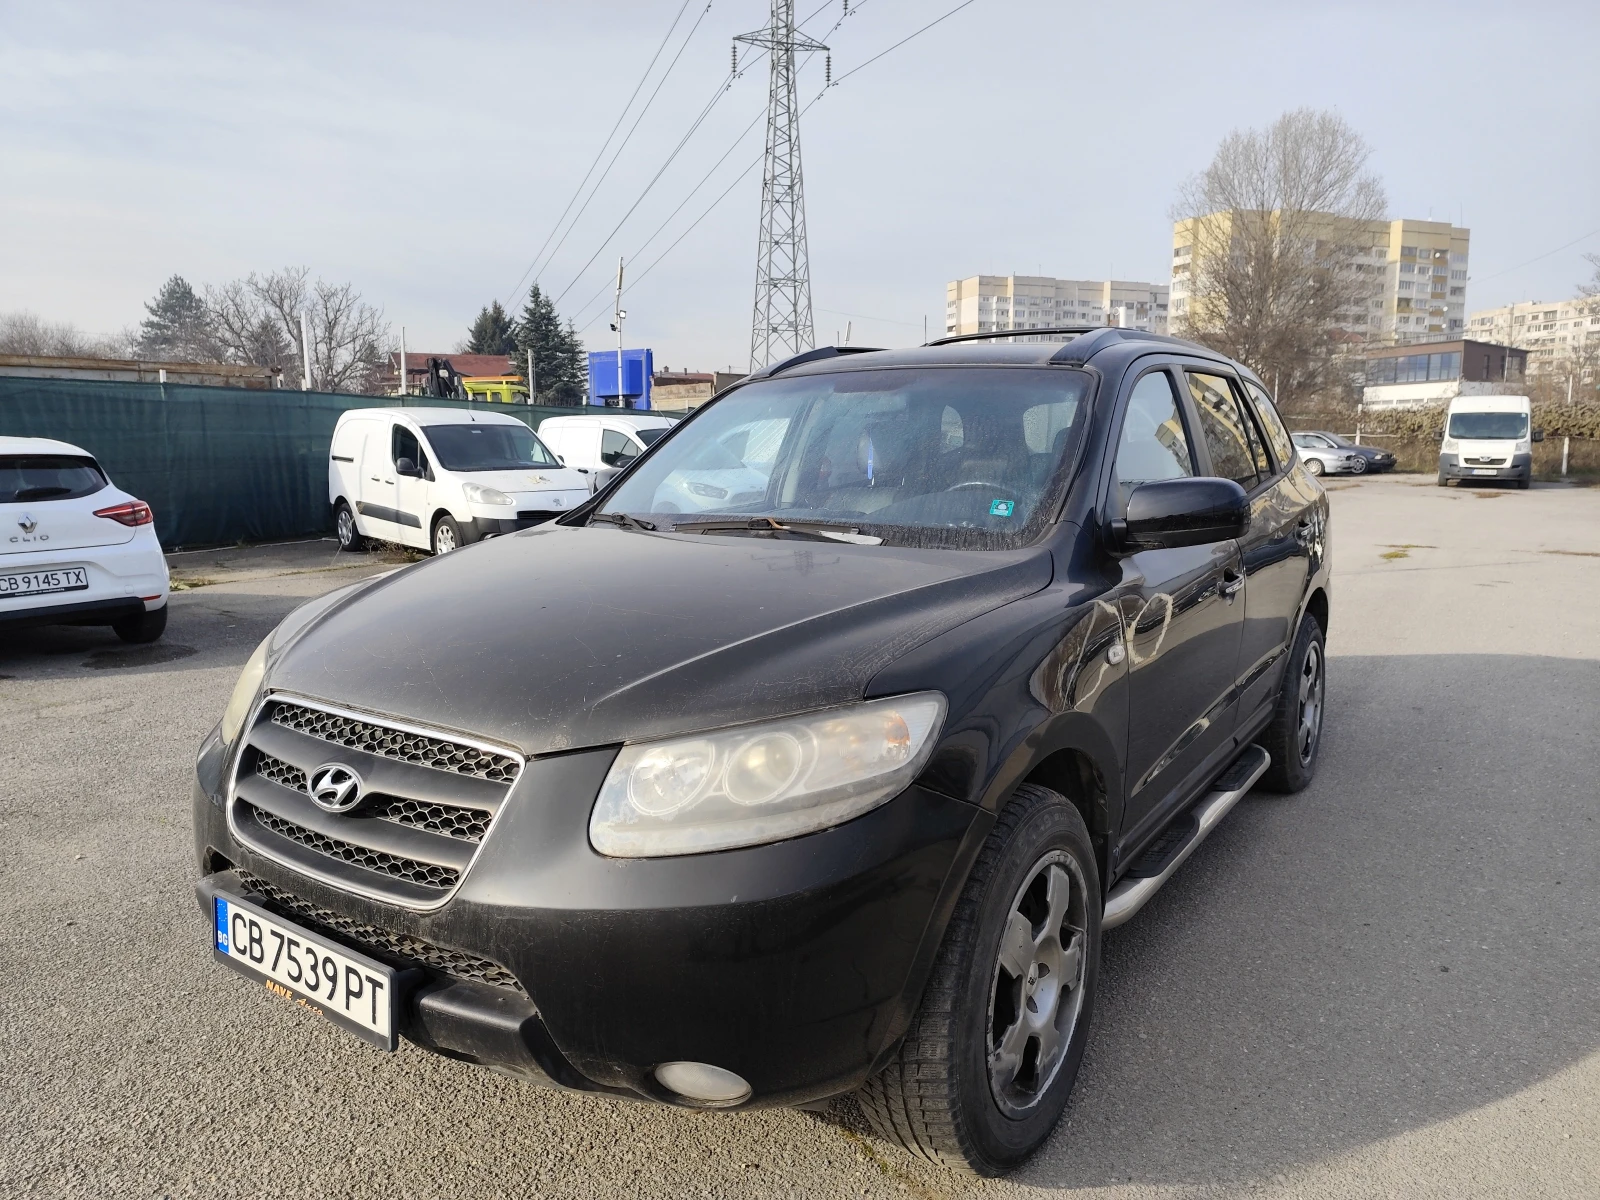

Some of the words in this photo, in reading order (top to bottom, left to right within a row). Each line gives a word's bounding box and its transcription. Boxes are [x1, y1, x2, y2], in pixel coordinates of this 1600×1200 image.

[9, 534, 49, 543] CLIO
[0, 577, 20, 592] CB
[22, 573, 61, 589] 9145
[62, 570, 84, 585] TX
[217, 930, 229, 946] BG
[231, 912, 265, 965] CB
[270, 928, 339, 1001] 7539
[345, 964, 384, 1026] PT
[265, 979, 293, 1001] NAVE
[295, 998, 324, 1016] Auto
